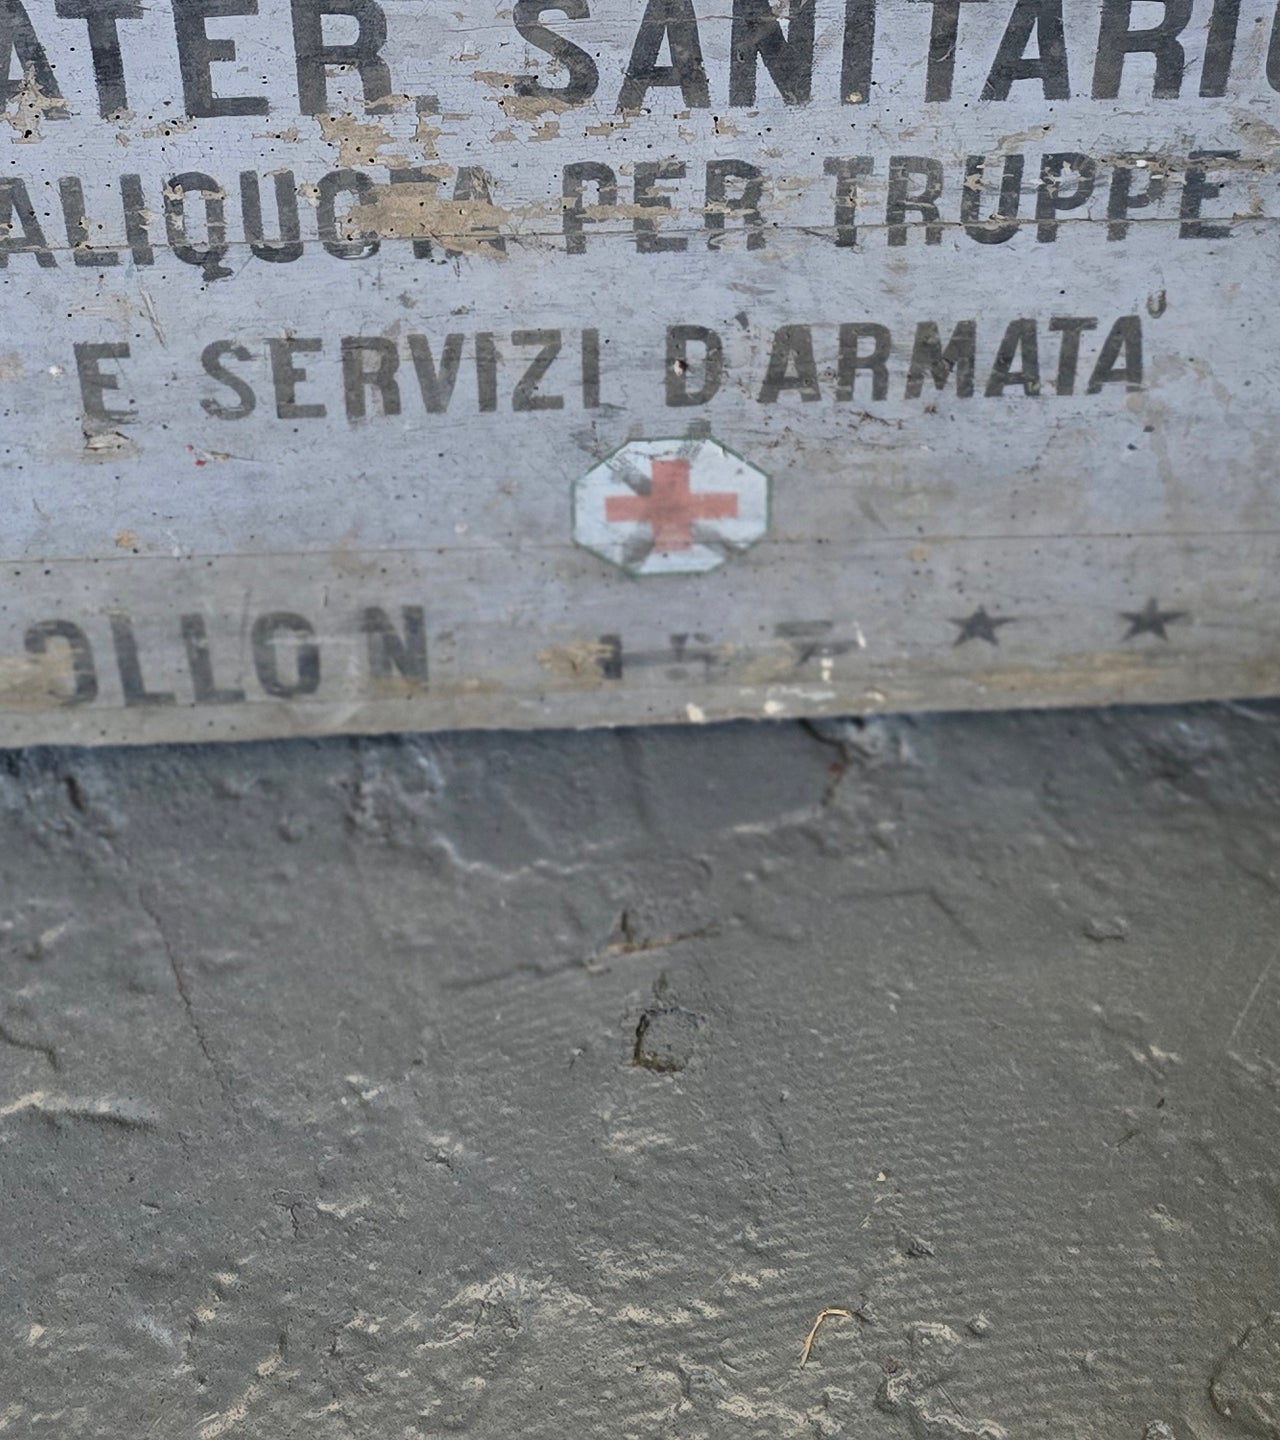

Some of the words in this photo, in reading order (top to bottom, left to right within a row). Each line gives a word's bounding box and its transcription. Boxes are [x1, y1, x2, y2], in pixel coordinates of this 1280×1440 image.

[562, 158, 765, 255] PER
[823, 150, 1242, 248] TRUPPE
[72, 340, 138, 424] E
[200, 328, 600, 422] SERVIZI
